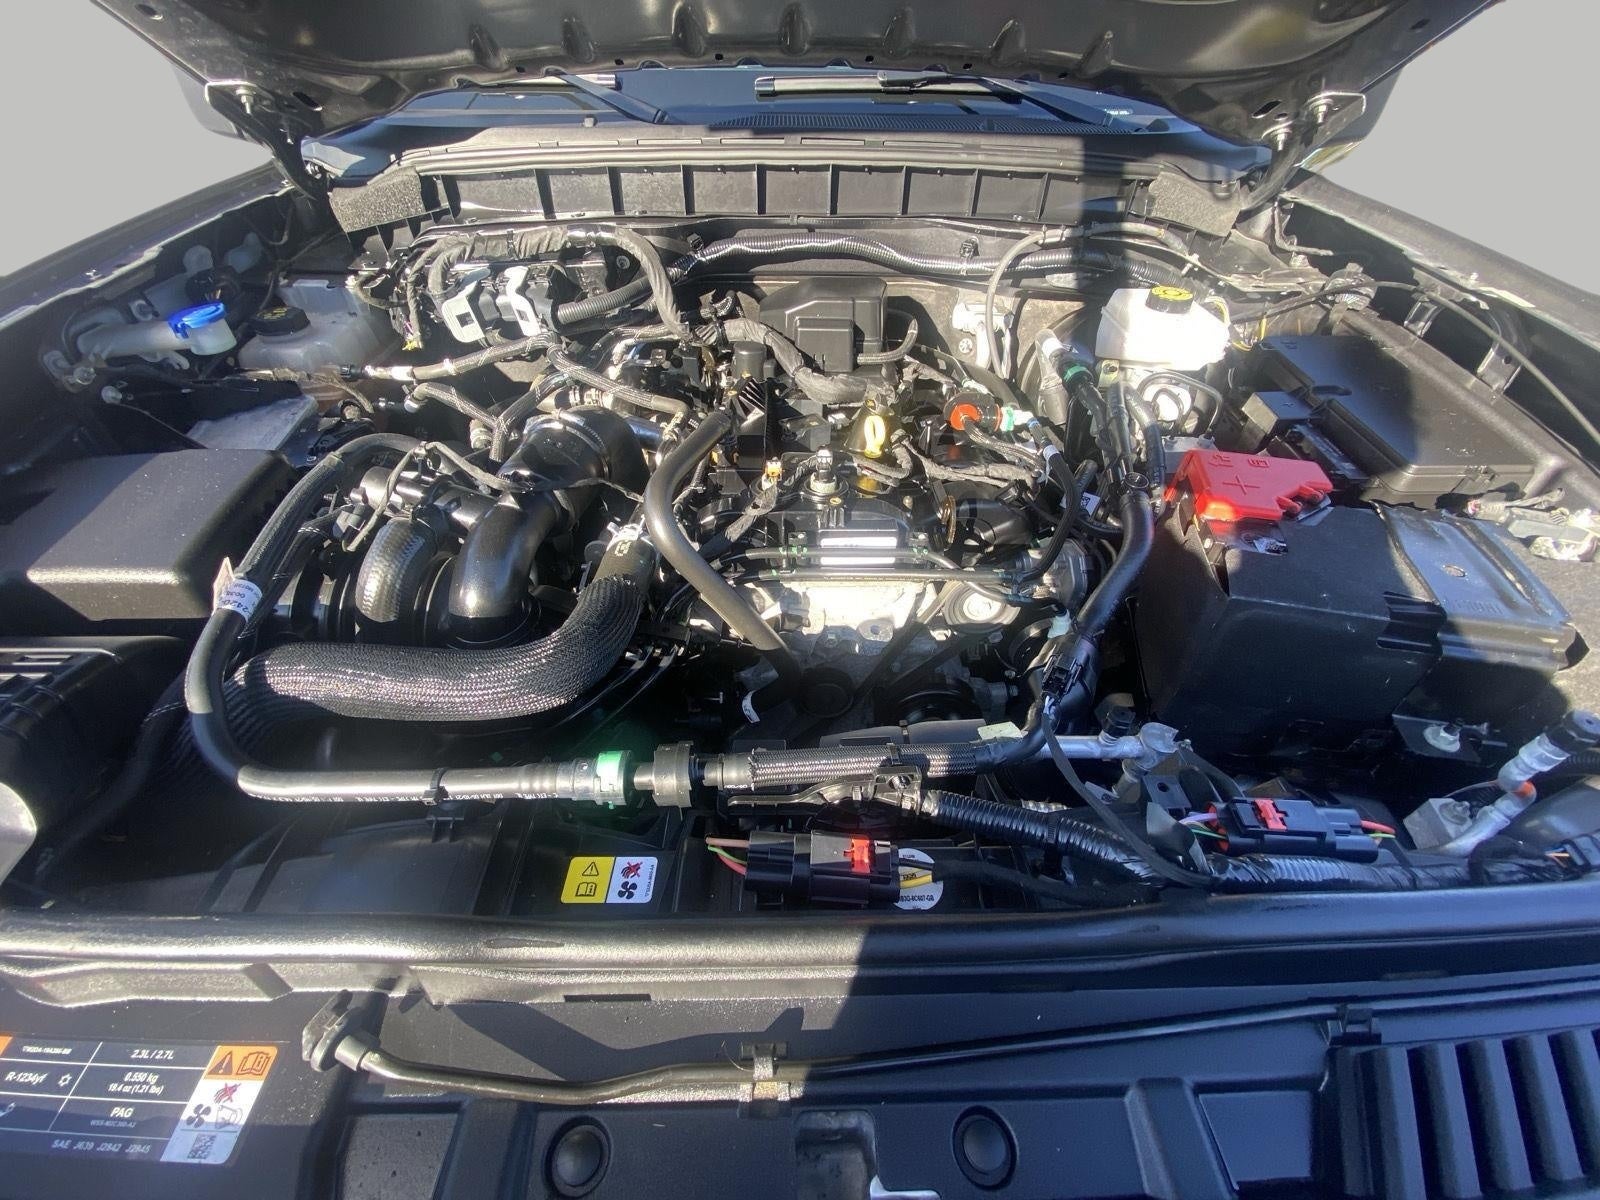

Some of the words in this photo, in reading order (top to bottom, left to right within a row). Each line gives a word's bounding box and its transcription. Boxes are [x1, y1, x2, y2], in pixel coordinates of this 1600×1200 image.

[130, 1048, 150, 1059] 2.3L
[155, 1049, 174, 1060] 2.7L
[5, 1072, 47, 1085] R-1234yf
[124, 1071, 147, 1082] 0.550
[146, 1072, 159, 1085] kg
[131, 1084, 149, 1095] (1.21
[110, 1106, 135, 1118] PAG
[51, 1139, 72, 1149] SAE
